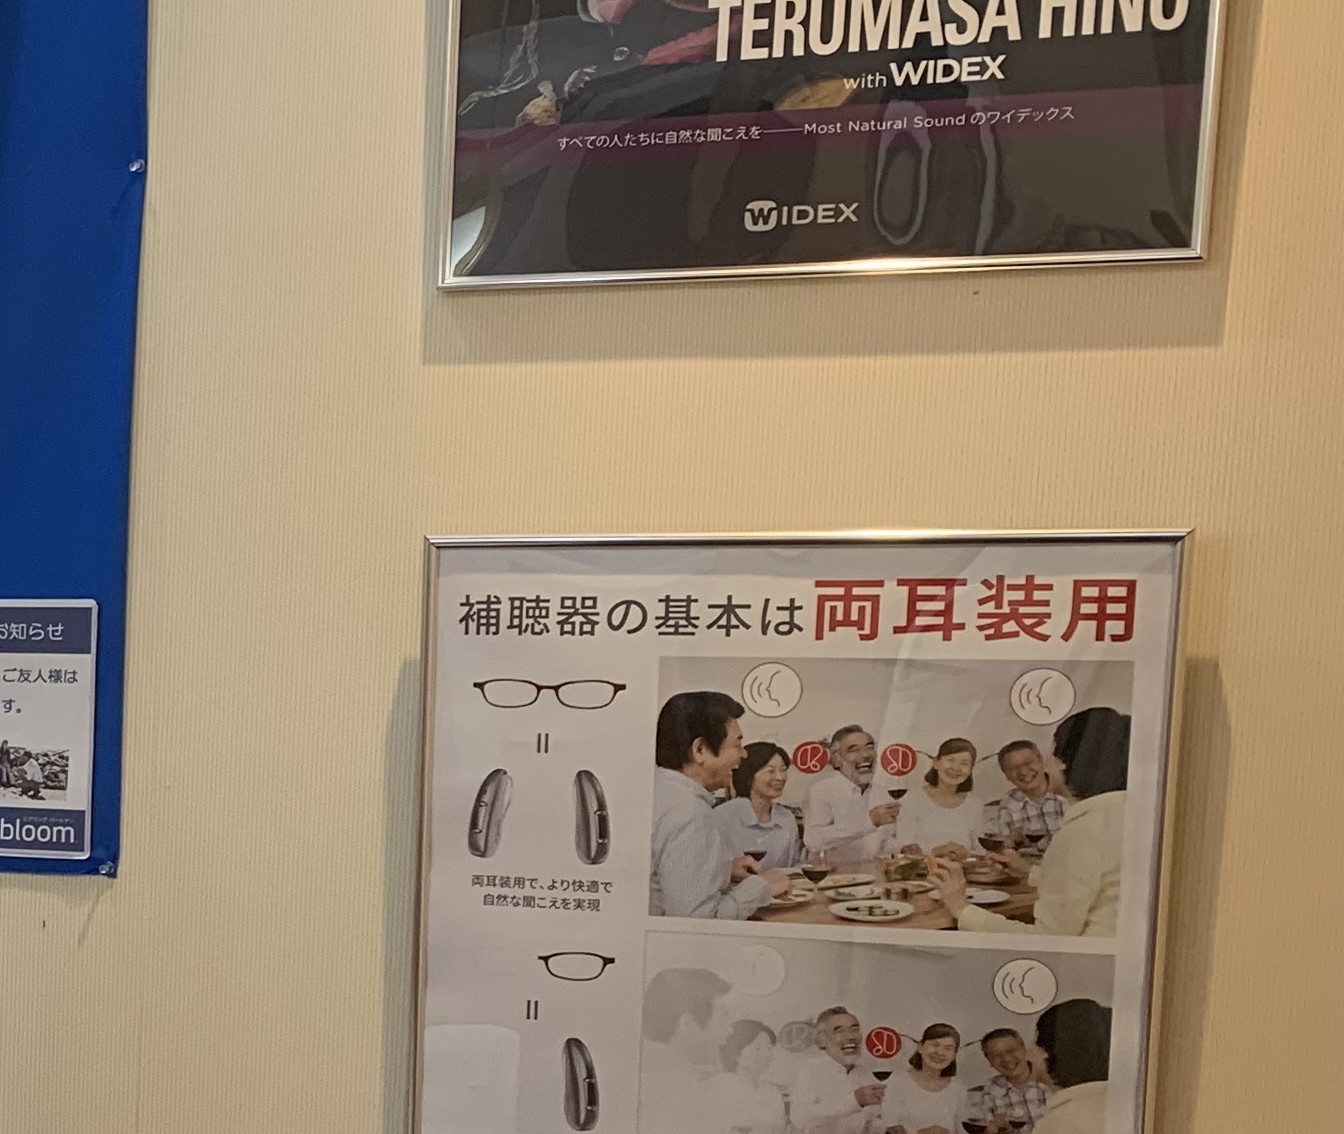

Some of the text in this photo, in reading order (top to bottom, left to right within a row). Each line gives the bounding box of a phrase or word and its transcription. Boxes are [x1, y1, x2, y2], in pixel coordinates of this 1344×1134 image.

[708, 0, 1021, 63] TERUMASA
[843, 55, 1007, 90] with WIDEX
[804, 120, 842, 135] Most
[848, 116, 908, 133] Natural
[913, 113, 965, 128] Sound
[970, 106, 1075, 125] のワイデックス
[743, 200, 859, 232] WIDEX
[0, 818, 75, 844] bloom
[470, 873, 614, 896] 両耳装用で、より快適で
[482, 893, 602, 914] 自然な聞こえを実現
